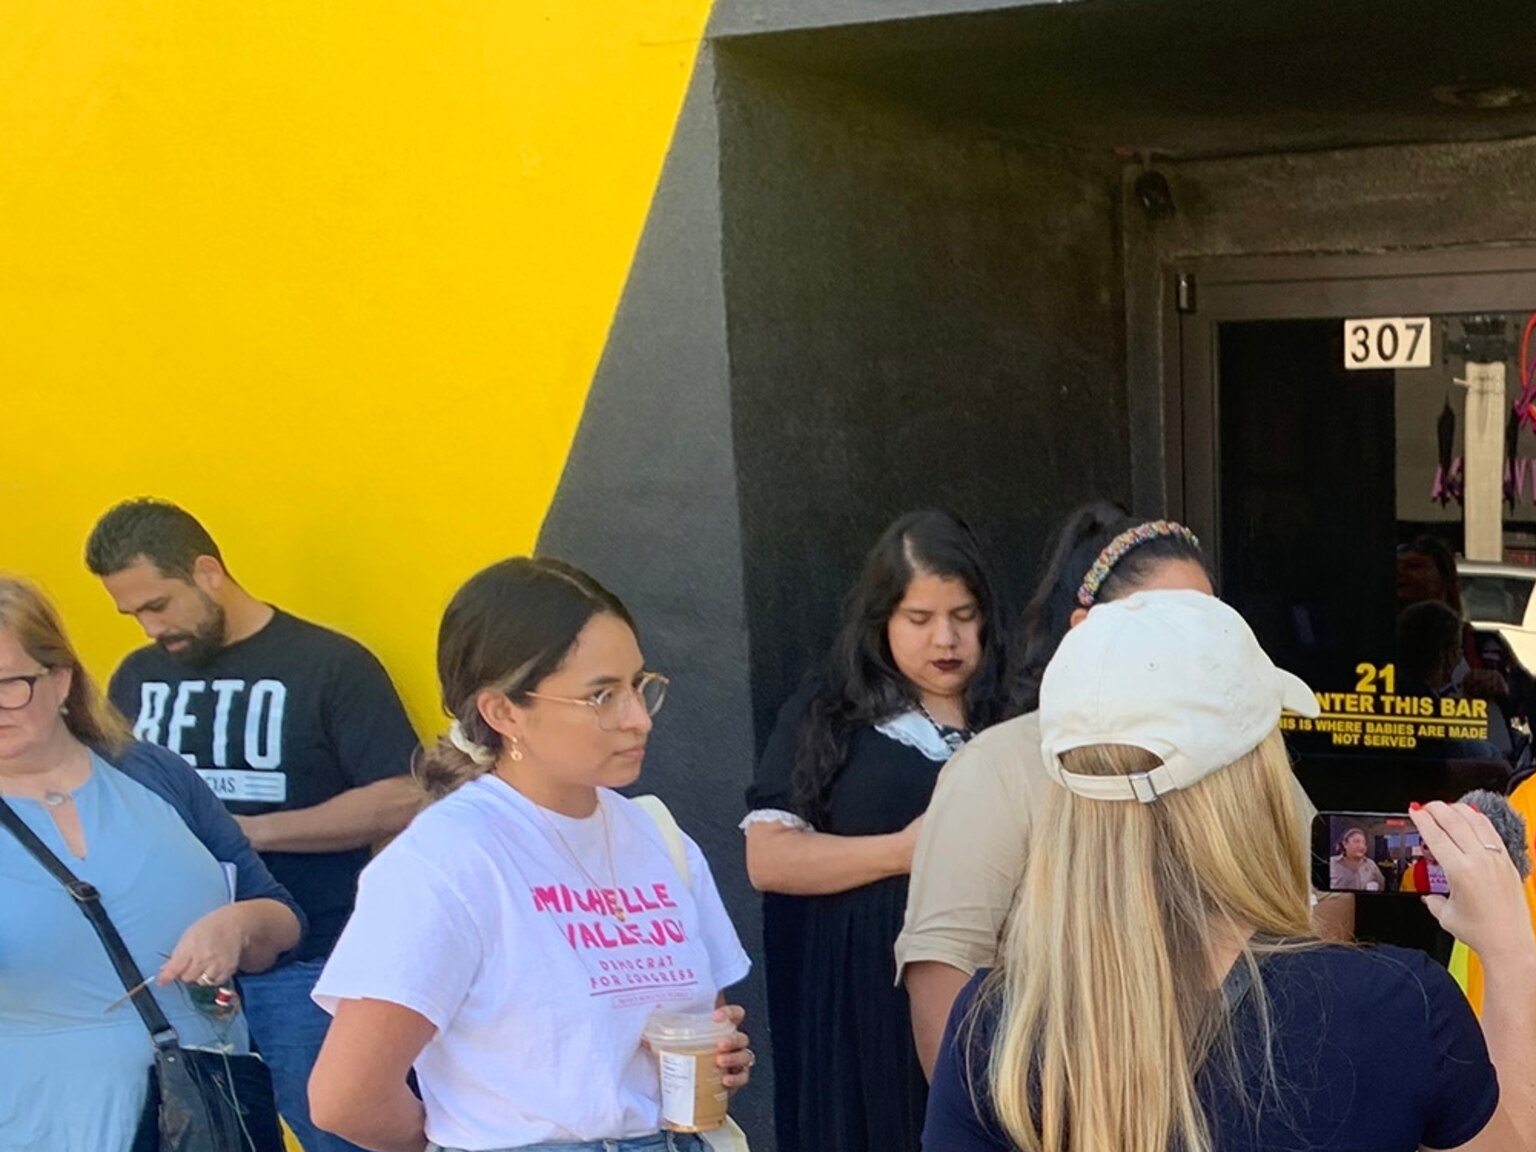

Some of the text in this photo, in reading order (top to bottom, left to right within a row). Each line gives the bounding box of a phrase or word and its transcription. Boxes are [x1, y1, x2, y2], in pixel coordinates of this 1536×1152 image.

[1351, 323, 1424, 363] 307
[1355, 662, 1395, 693] 21
[1315, 692, 1488, 717] NTER THIS BAR
[133, 679, 287, 769] BETO
[1300, 719, 1312, 730] IS
[1316, 720, 1362, 733] WHERE
[1366, 722, 1415, 735] BABIES
[1418, 725, 1446, 737] ARE
[1450, 727, 1488, 739] MADE
[1333, 733, 1417, 748] NOT SERVED
[590, 968, 694, 989] FOR CONGRESS
